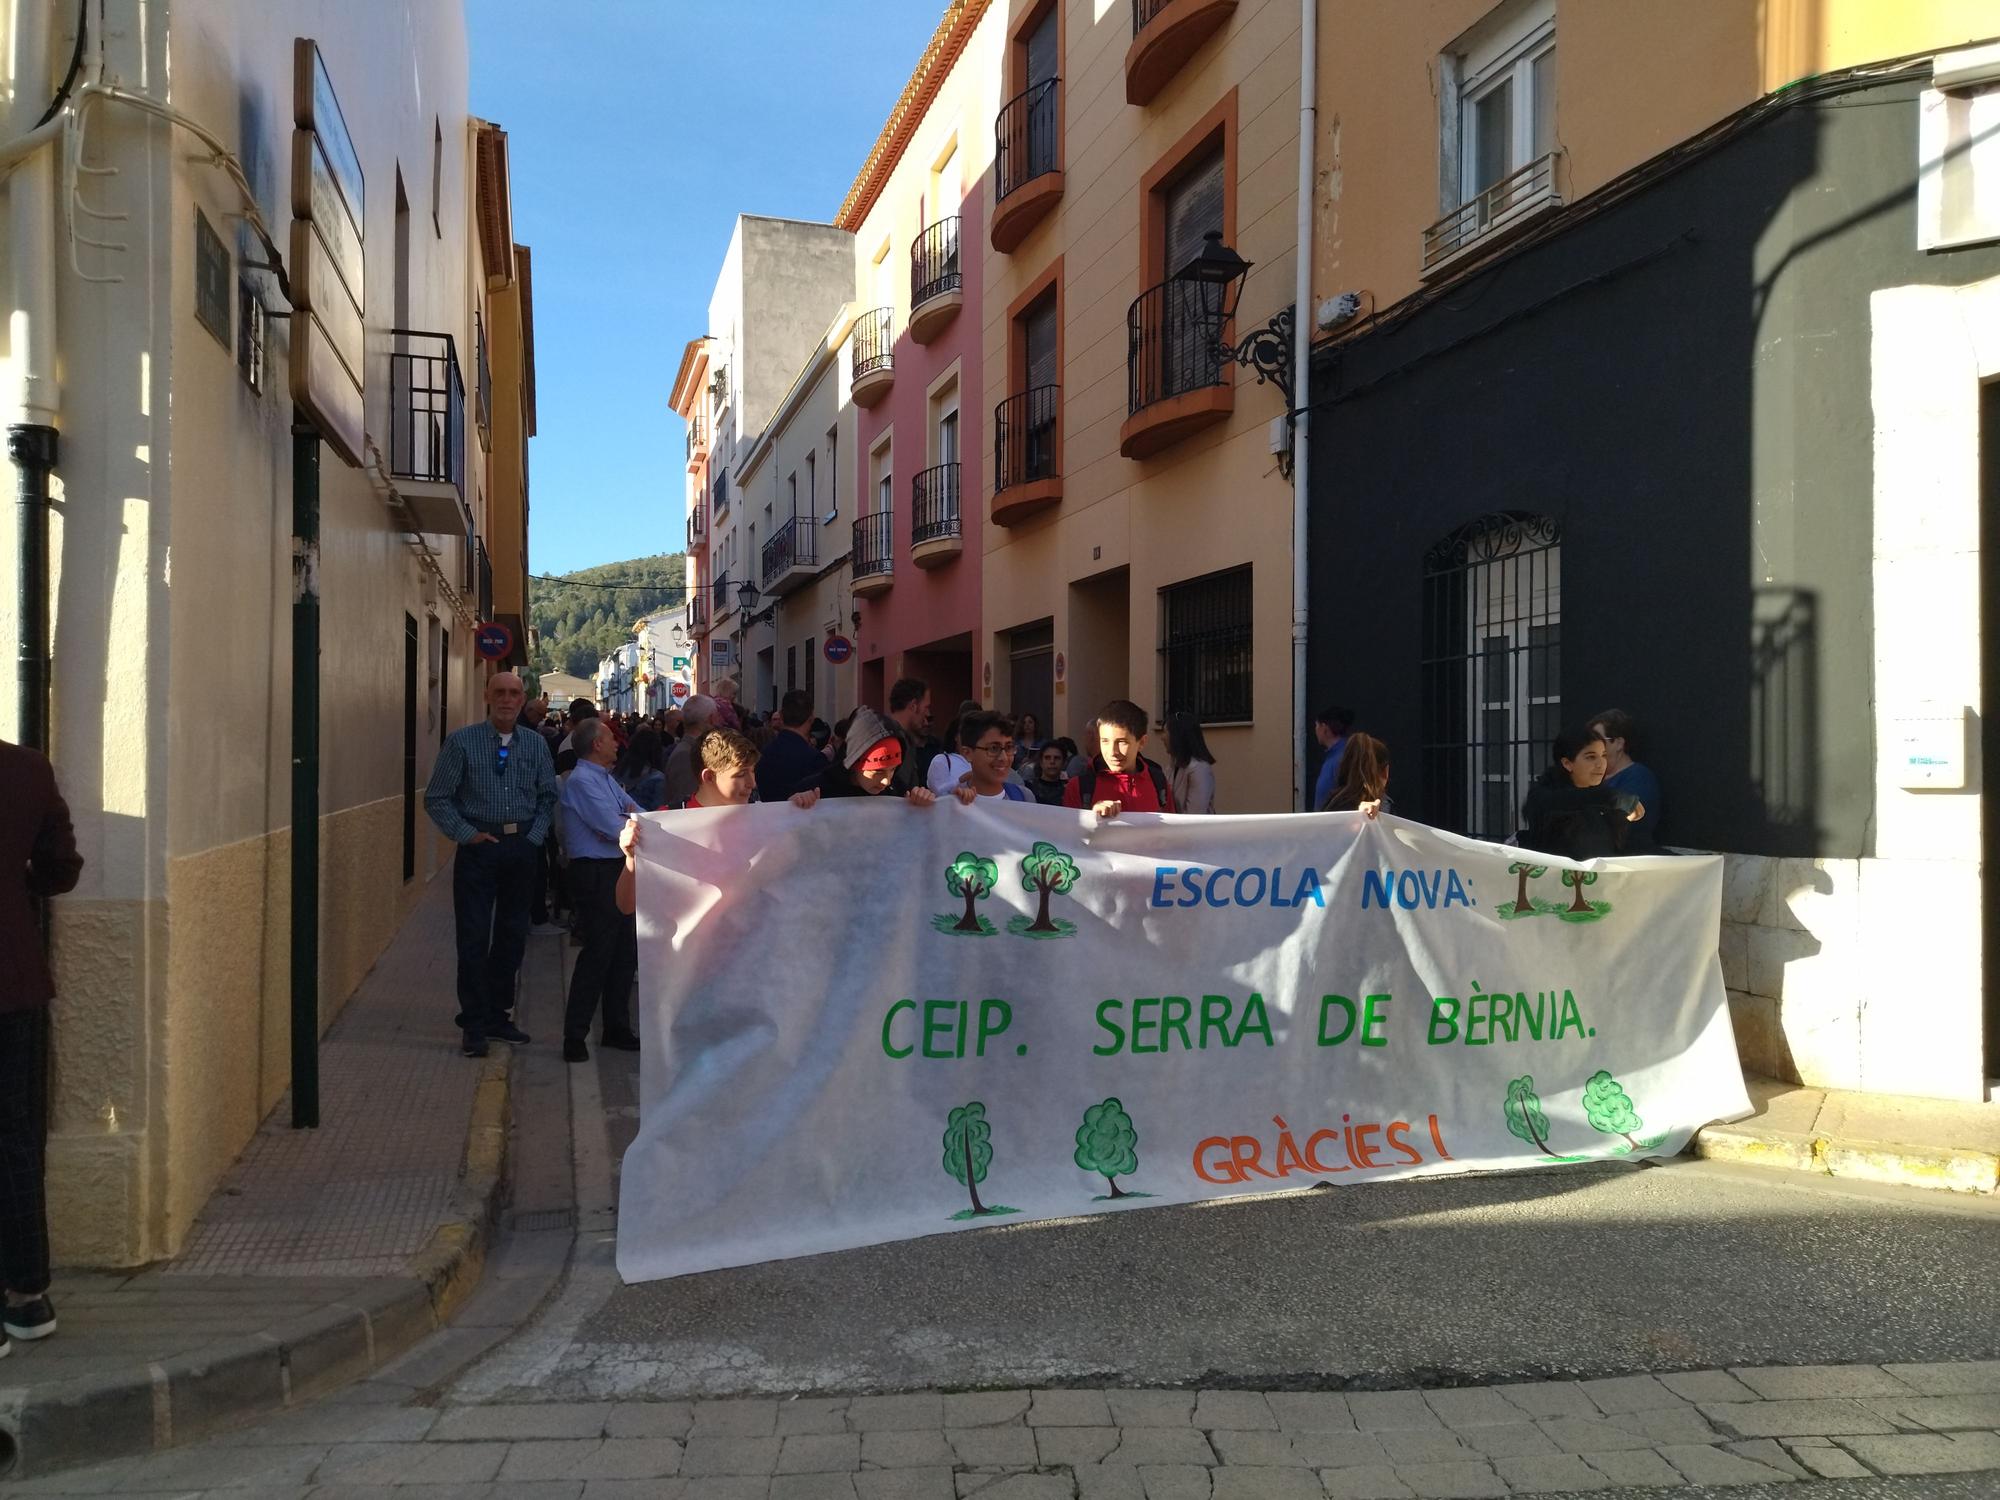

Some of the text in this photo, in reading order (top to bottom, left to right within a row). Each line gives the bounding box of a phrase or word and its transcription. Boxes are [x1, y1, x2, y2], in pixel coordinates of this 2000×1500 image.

[1151, 867, 1477, 910] ESCOLA NOVA:
[881, 980, 1597, 1060] CEIP. SERRA DE BÈRNIA.
